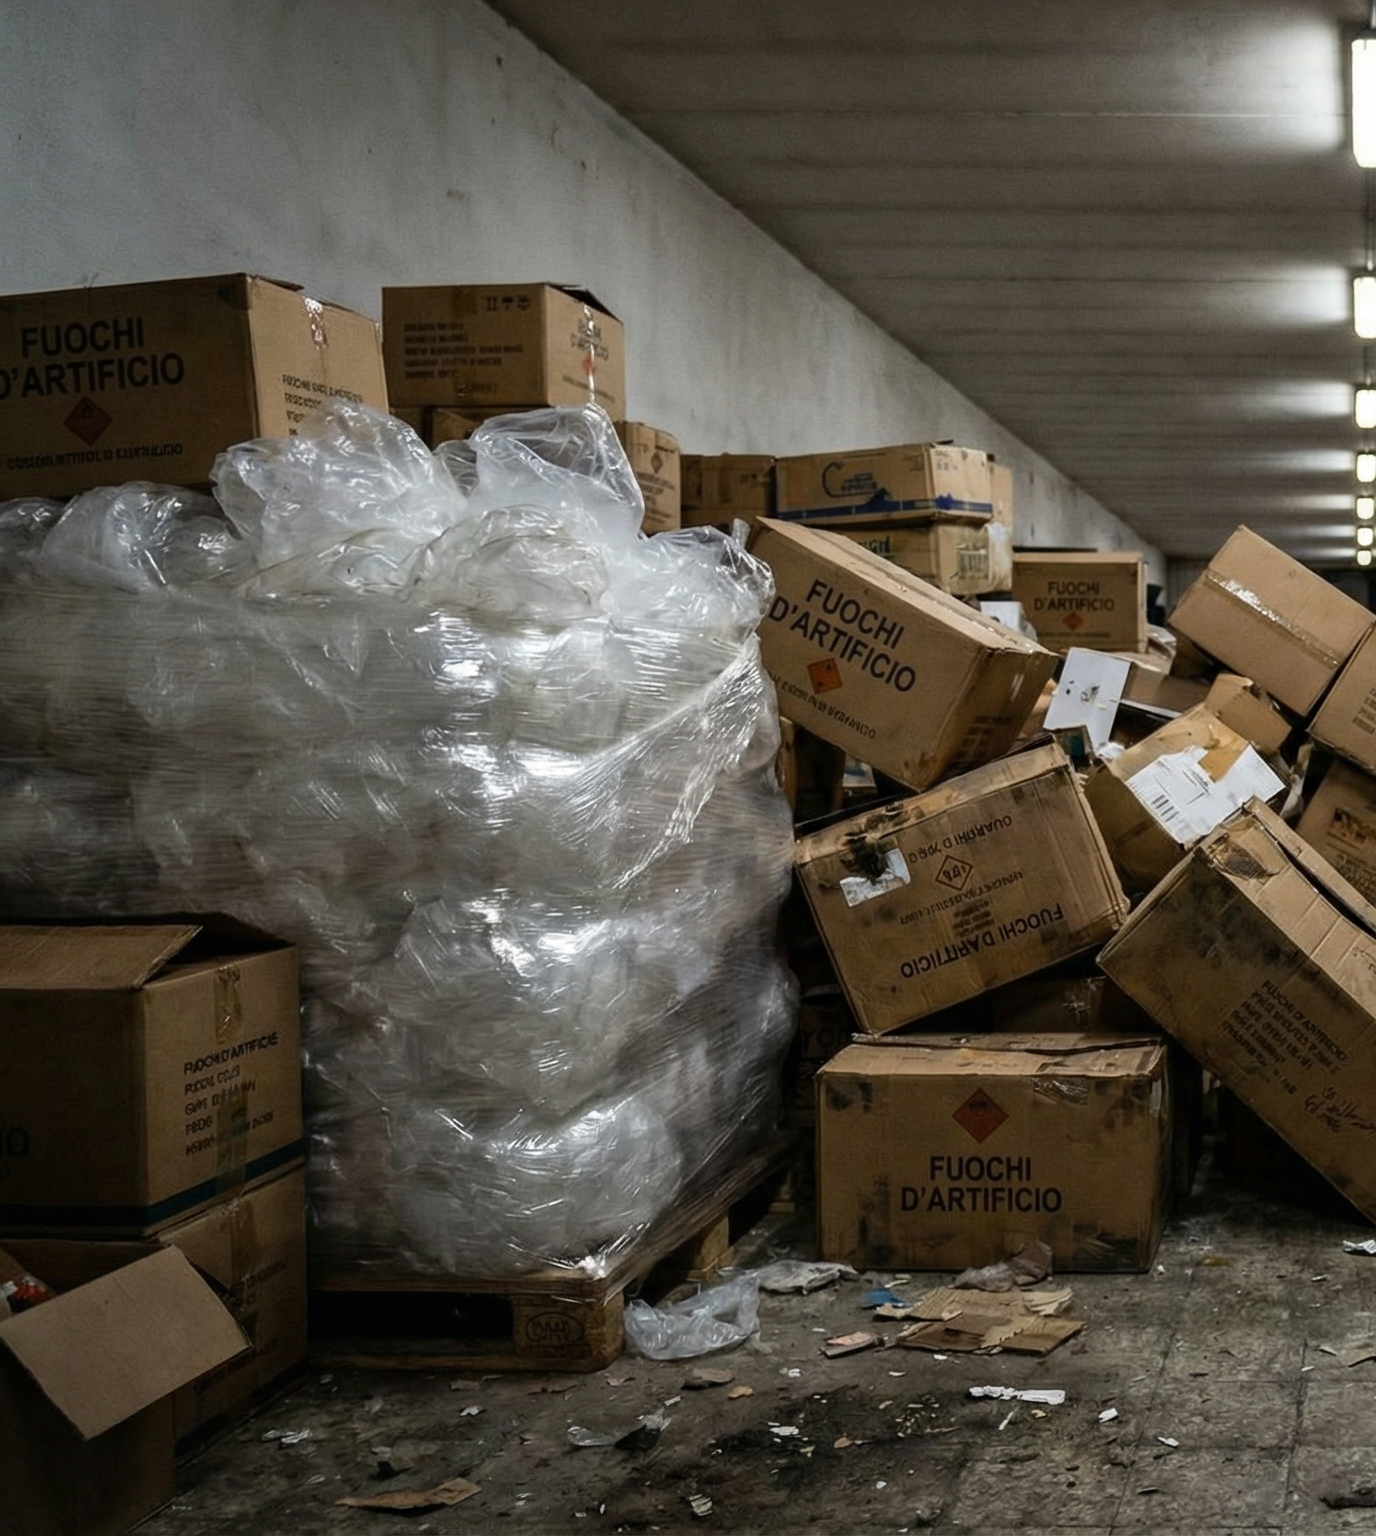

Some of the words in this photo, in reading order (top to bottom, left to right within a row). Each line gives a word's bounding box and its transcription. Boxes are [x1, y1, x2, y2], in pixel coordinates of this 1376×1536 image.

[21, 317, 144, 359] FUOCHI
[1047, 581, 1100, 595] FUOCHI
[806, 578, 905, 650] FUOCHI
[768, 596, 917, 693] D'ARTIFICIO
[1001, 903, 1065, 944] FUOCHI
[929, 1156, 1033, 1182] FUOCHI
[900, 1186, 1063, 1214] D'ARTIFICIO
